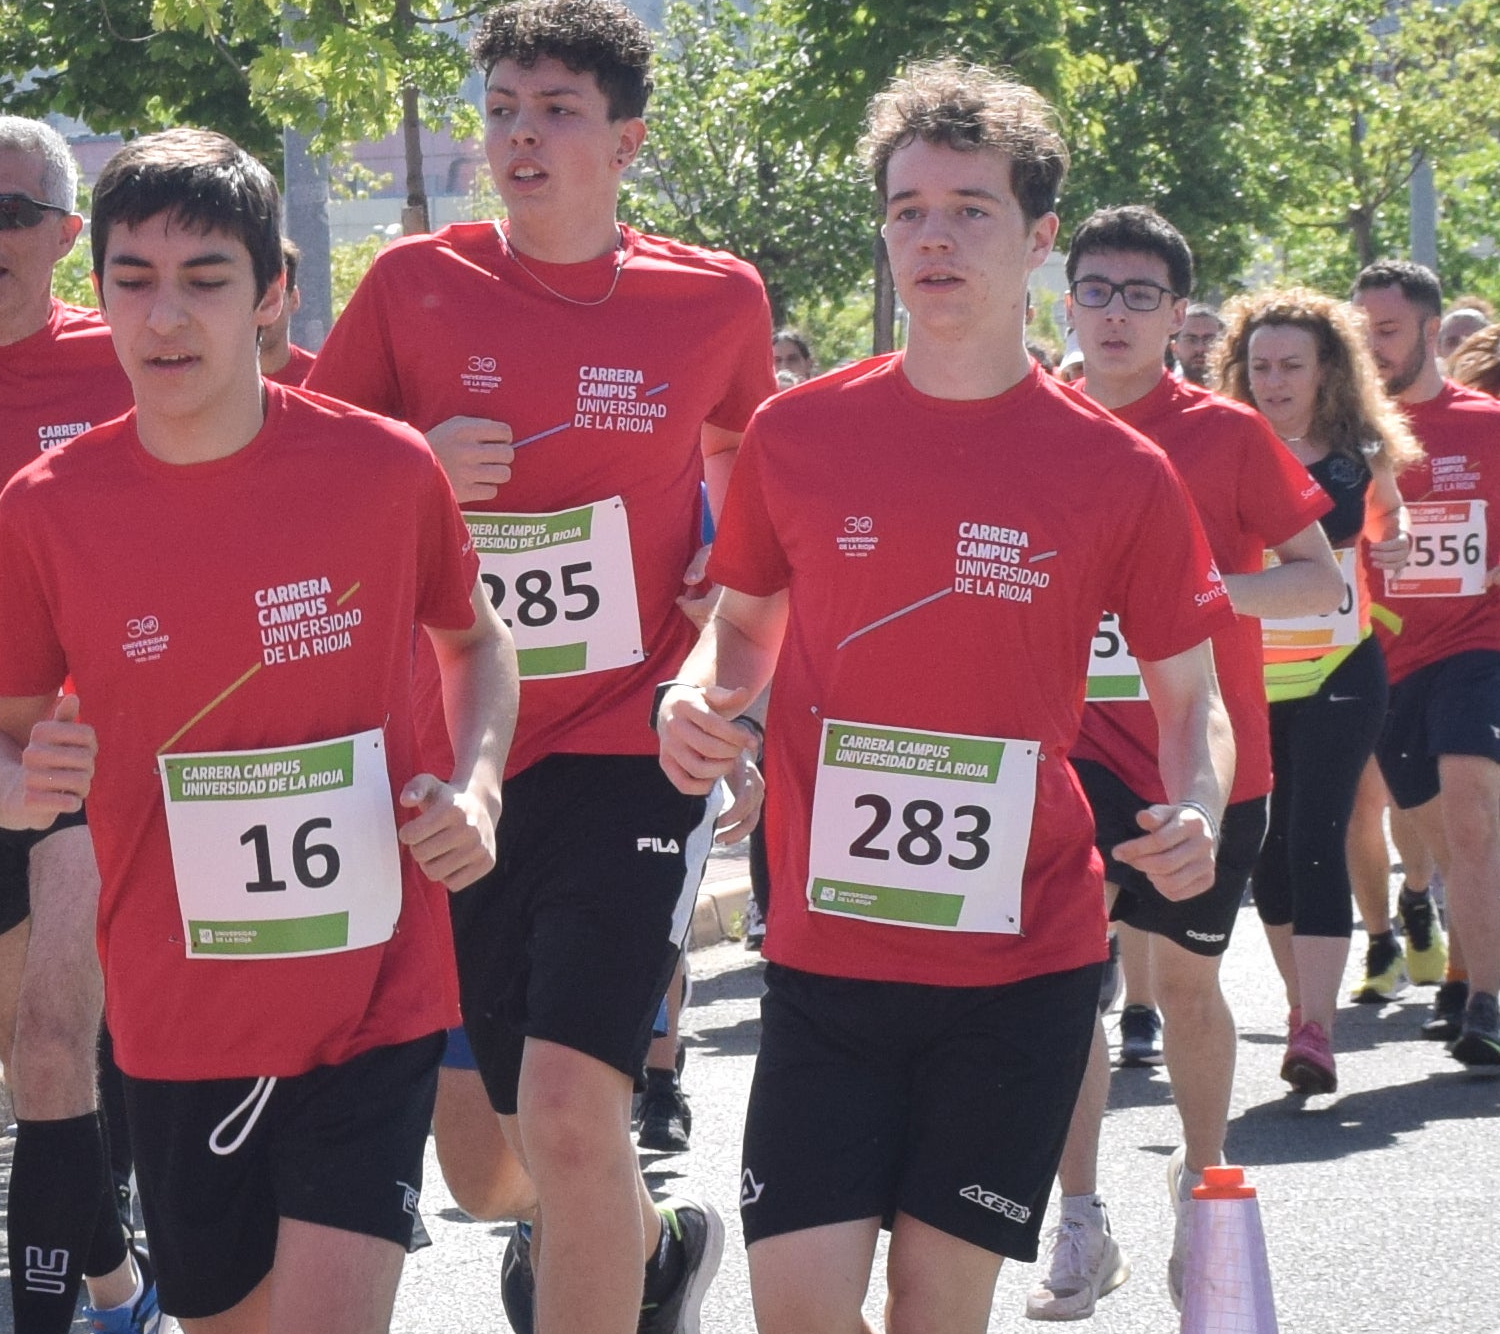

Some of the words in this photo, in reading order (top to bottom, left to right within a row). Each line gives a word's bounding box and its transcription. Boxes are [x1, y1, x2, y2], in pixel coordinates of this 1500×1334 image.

[579, 365, 644, 384] CARRERA
[578, 382, 637, 400] CAMPUS
[577, 398, 667, 418] UNIVERSIDAD
[38, 422, 93, 439] CARRERA
[574, 414, 593, 429] DE
[596, 415, 613, 430] LA
[617, 416, 654, 434] RIOJA
[501, 523, 546, 536] CAMPUS
[519, 538, 535, 549] DE
[536, 535, 550, 546] LA
[552, 527, 581, 542] RIOJA
[958, 521, 1029, 548] CARRERA
[956, 540, 1021, 564] CAMPUS
[1406, 532, 1480, 567] 556
[955, 559, 1050, 589] UNIVERSIDAD
[254, 576, 332, 608] CARRERA
[480, 561, 600, 628] 285
[954, 577, 974, 595] DE
[976, 579, 995, 597] LA
[998, 583, 1033, 604] RIOJA
[1194, 584, 1228, 607] Santa
[257, 597, 328, 628] CAMPUS
[260, 608, 362, 647] UNIVERSIDAD
[122, 635, 169, 651] UNIVERSIDAD
[263, 647, 286, 666] DE
[288, 641, 310, 661] LA
[313, 632, 352, 656] RIOJA
[839, 734, 895, 753] CARRERA
[896, 741, 950, 759] CAMPUS
[182, 765, 241, 781] CARRERA
[243, 759, 301, 779] CAMPUS
[835, 749, 916, 770] UNIVERSIDAD
[917, 758, 935, 772] DE
[935, 759, 952, 774] LA
[953, 761, 989, 778] RIOJA
[182, 779, 267, 796] UNIVERSIDAD
[268, 777, 287, 793] DE
[288, 775, 307, 790] LA
[309, 768, 344, 788] RIOJA
[849, 793, 992, 871] 283
[239, 817, 341, 893] 16
[637, 837, 680, 854] FILA
